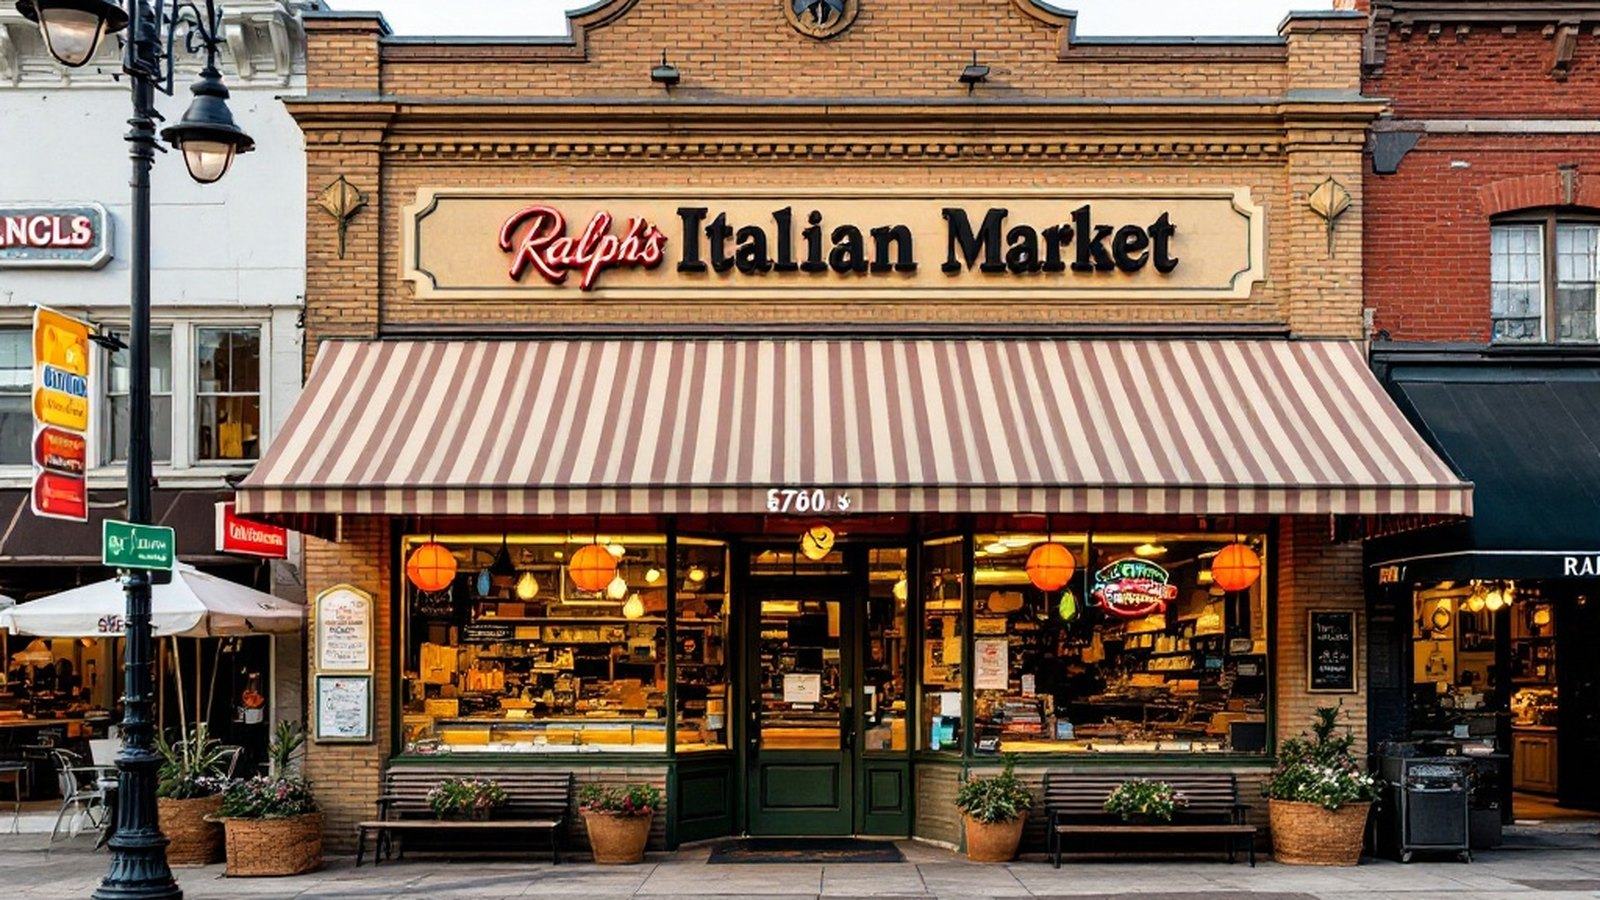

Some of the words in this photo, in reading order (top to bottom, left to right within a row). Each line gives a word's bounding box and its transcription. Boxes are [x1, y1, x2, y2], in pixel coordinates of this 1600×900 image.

[0, 216, 91, 245] NCLS
[499, 205, 668, 291] Ralph's
[676, 206, 917, 275] Italian
[942, 204, 1179, 275] Market
